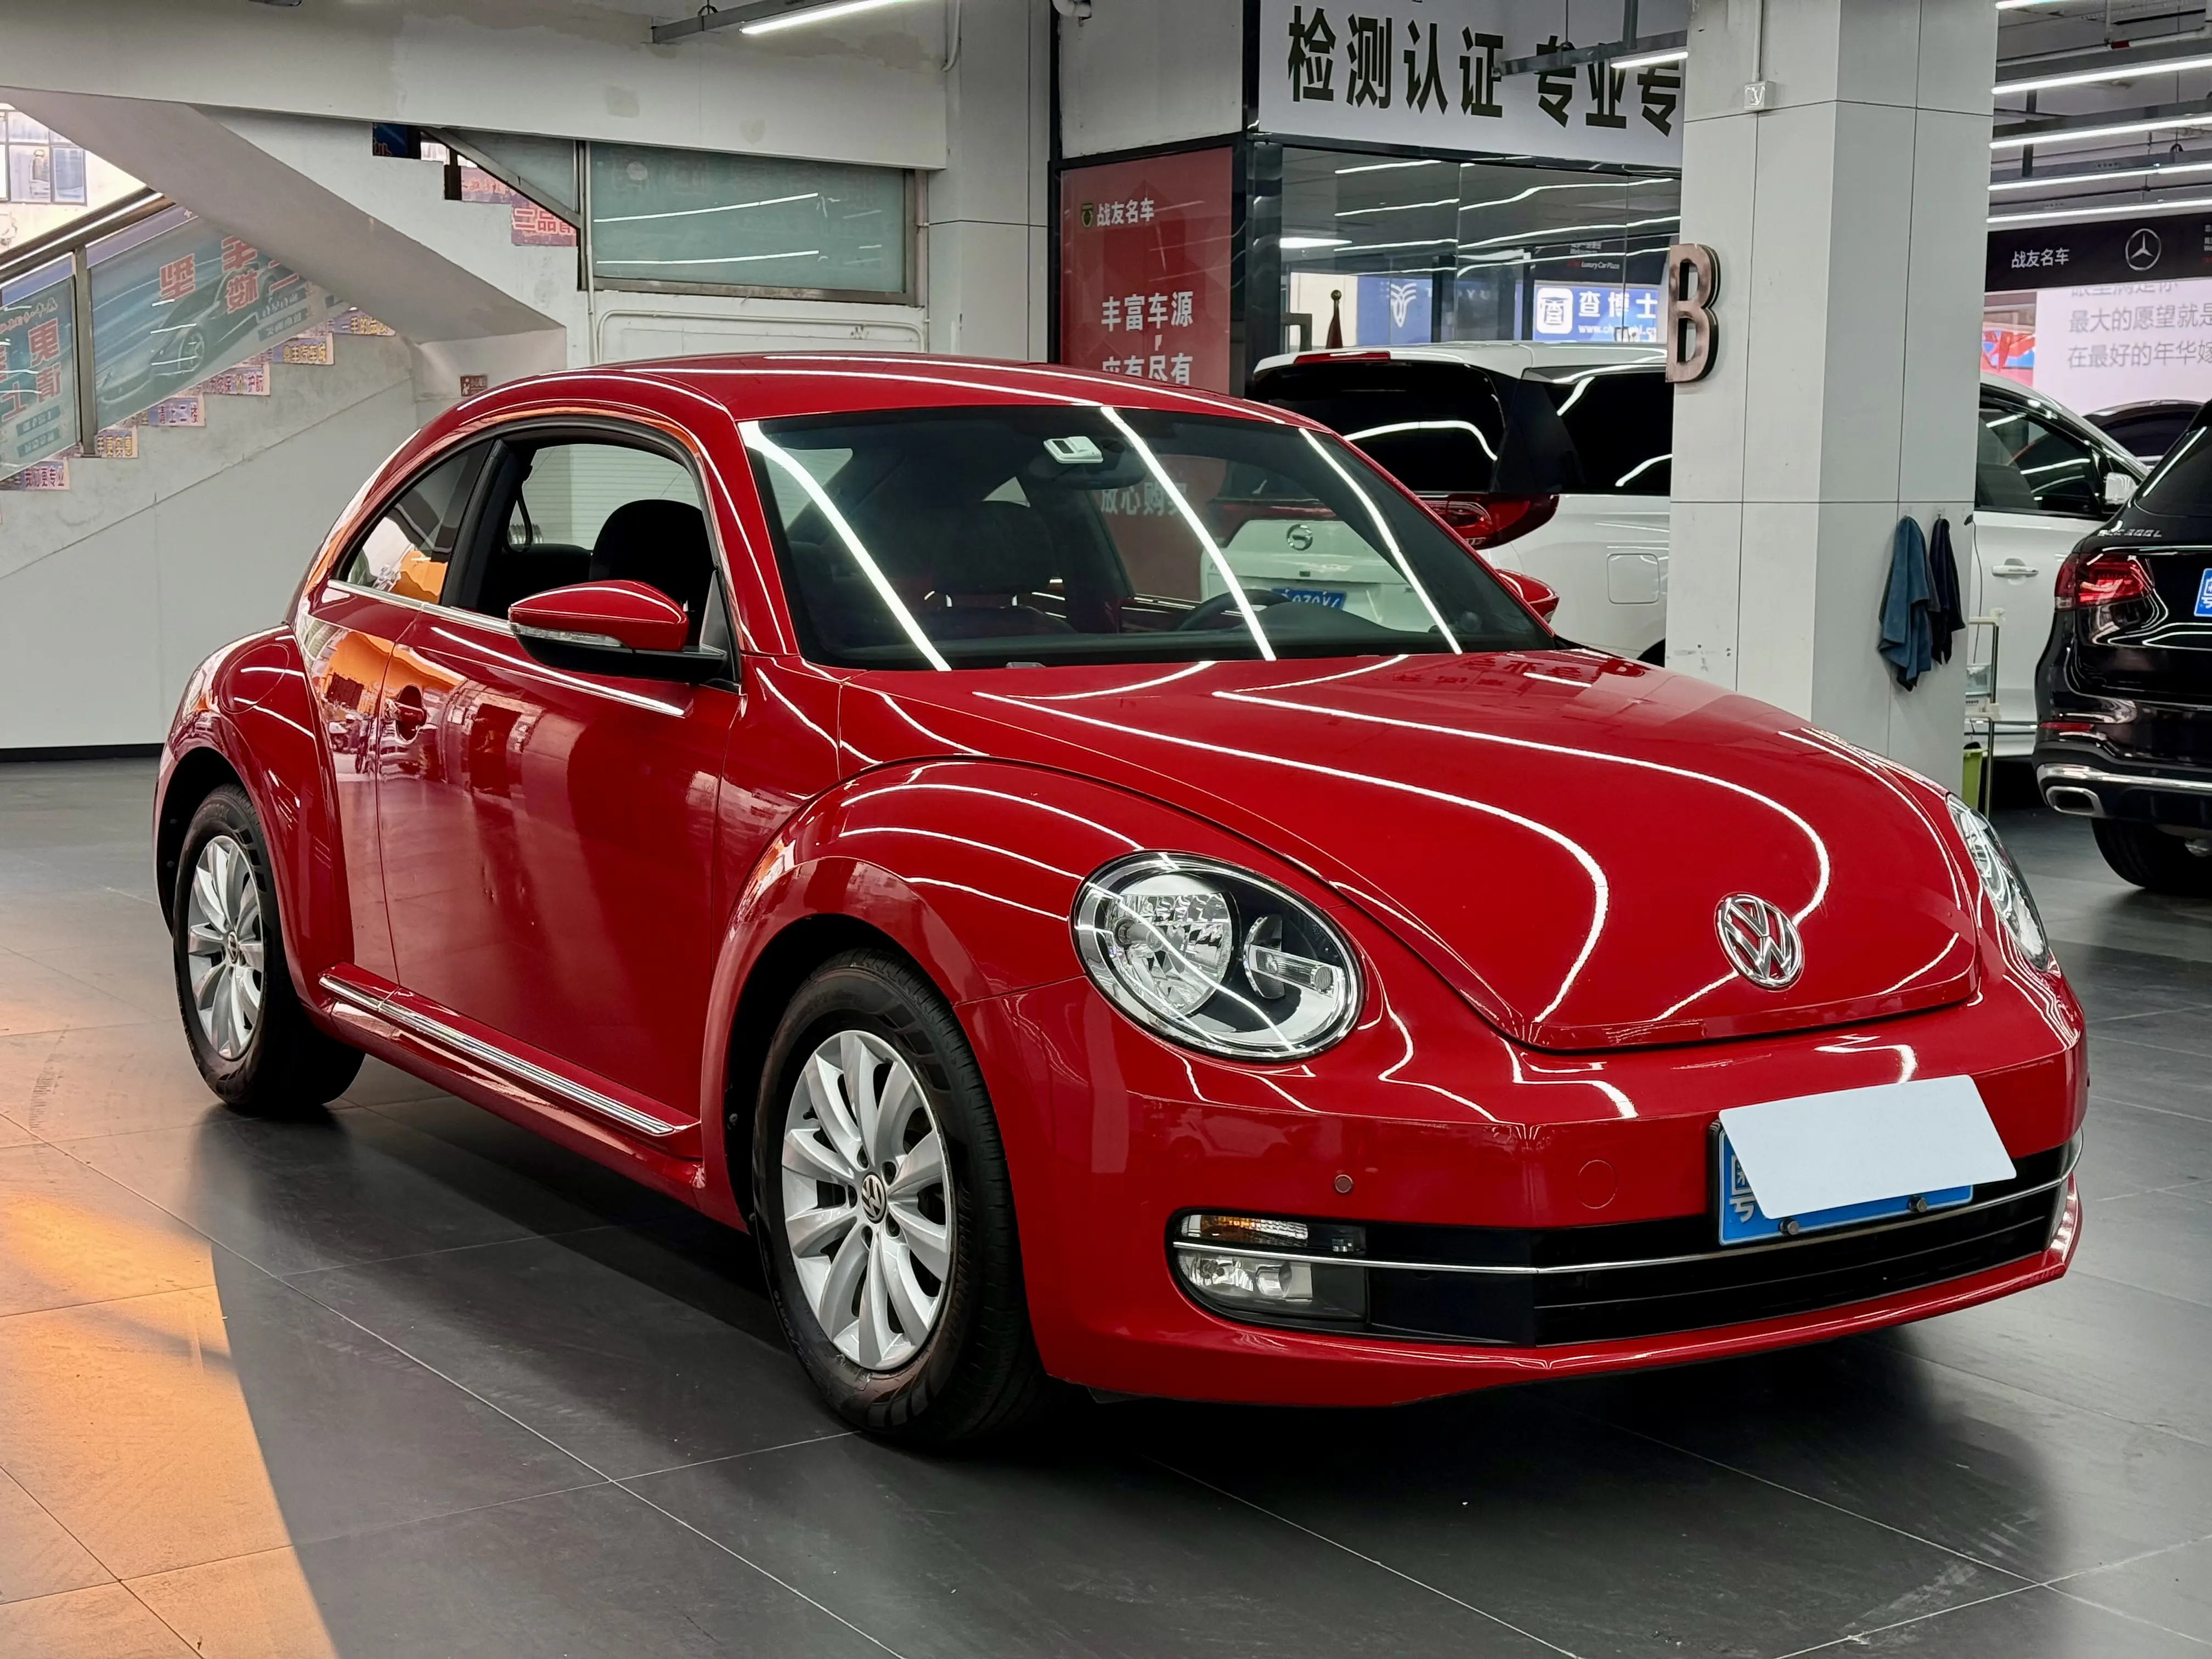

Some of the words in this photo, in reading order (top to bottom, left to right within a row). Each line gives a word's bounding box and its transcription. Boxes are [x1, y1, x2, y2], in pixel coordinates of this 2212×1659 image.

[1287, 5, 1503, 118] 检测认证
[1097, 197, 1155, 227] 战友名车
[2011, 247, 2070, 269] 战友名车
[1101, 291, 1194, 332] 丰富车源
[1578, 290, 1658, 319] 查博士
[1665, 243, 1720, 383] B
